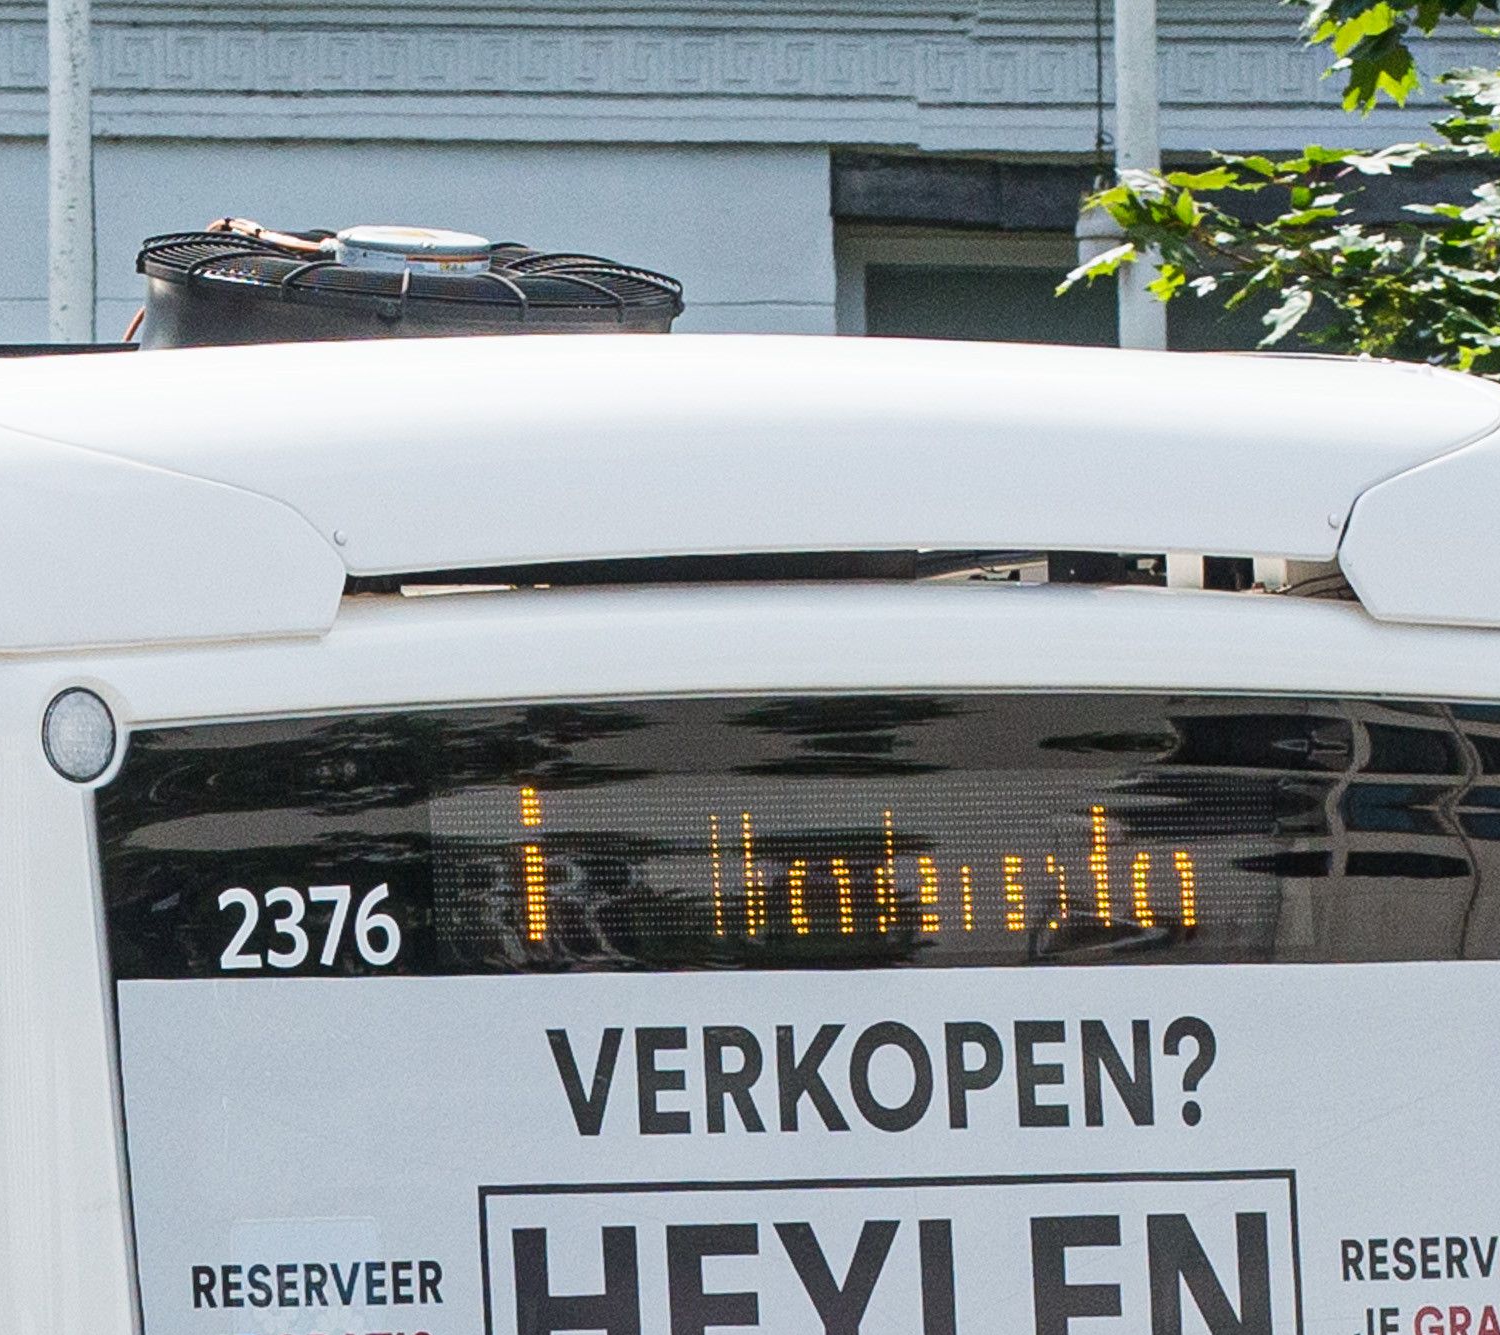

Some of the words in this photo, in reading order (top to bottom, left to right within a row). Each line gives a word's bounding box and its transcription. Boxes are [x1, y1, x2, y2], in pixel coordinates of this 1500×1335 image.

[217, 882, 401, 970] 2376
[545, 1015, 1217, 1137] VERKOPEN?
[191, 1260, 444, 1309] RESERVEER
